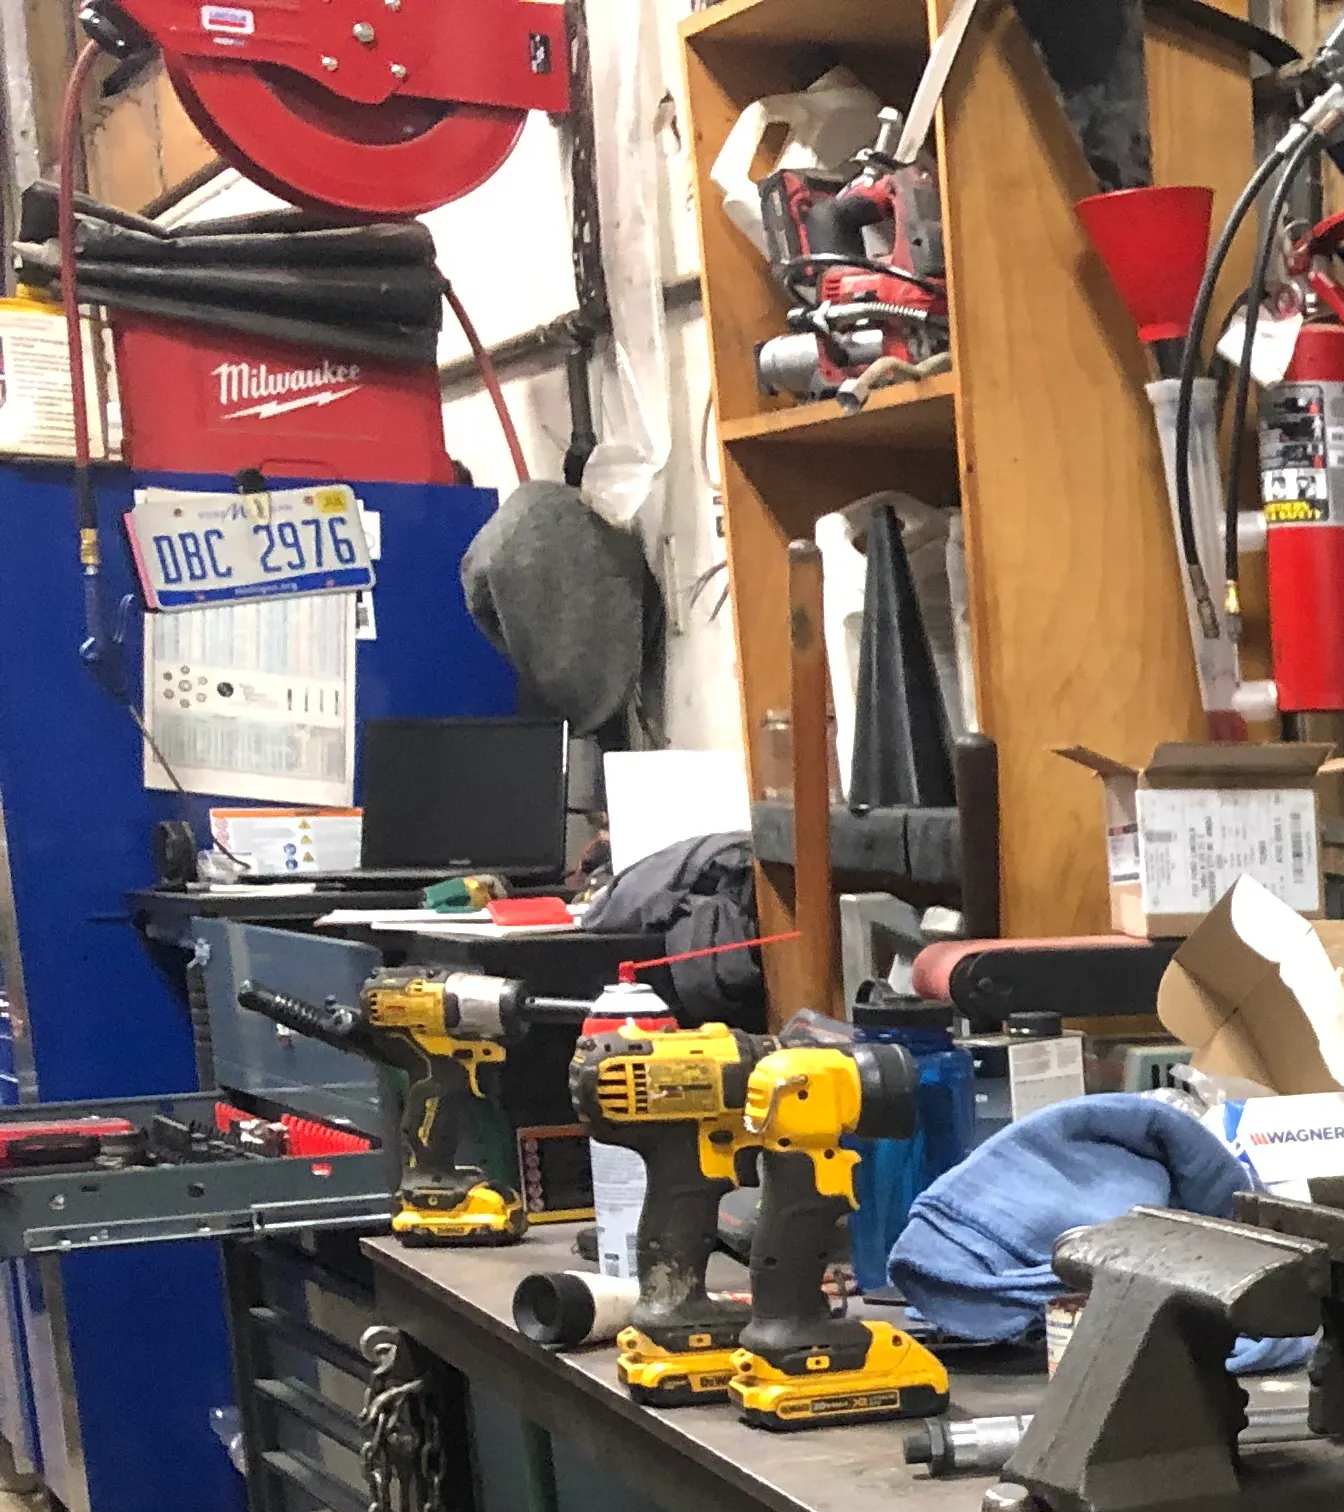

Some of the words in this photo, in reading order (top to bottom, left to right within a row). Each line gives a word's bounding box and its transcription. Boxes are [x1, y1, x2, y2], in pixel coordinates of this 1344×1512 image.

[210, 360, 361, 405] Milwaukee
[153, 528, 232, 584] DBC
[252, 515, 356, 573] 2976
